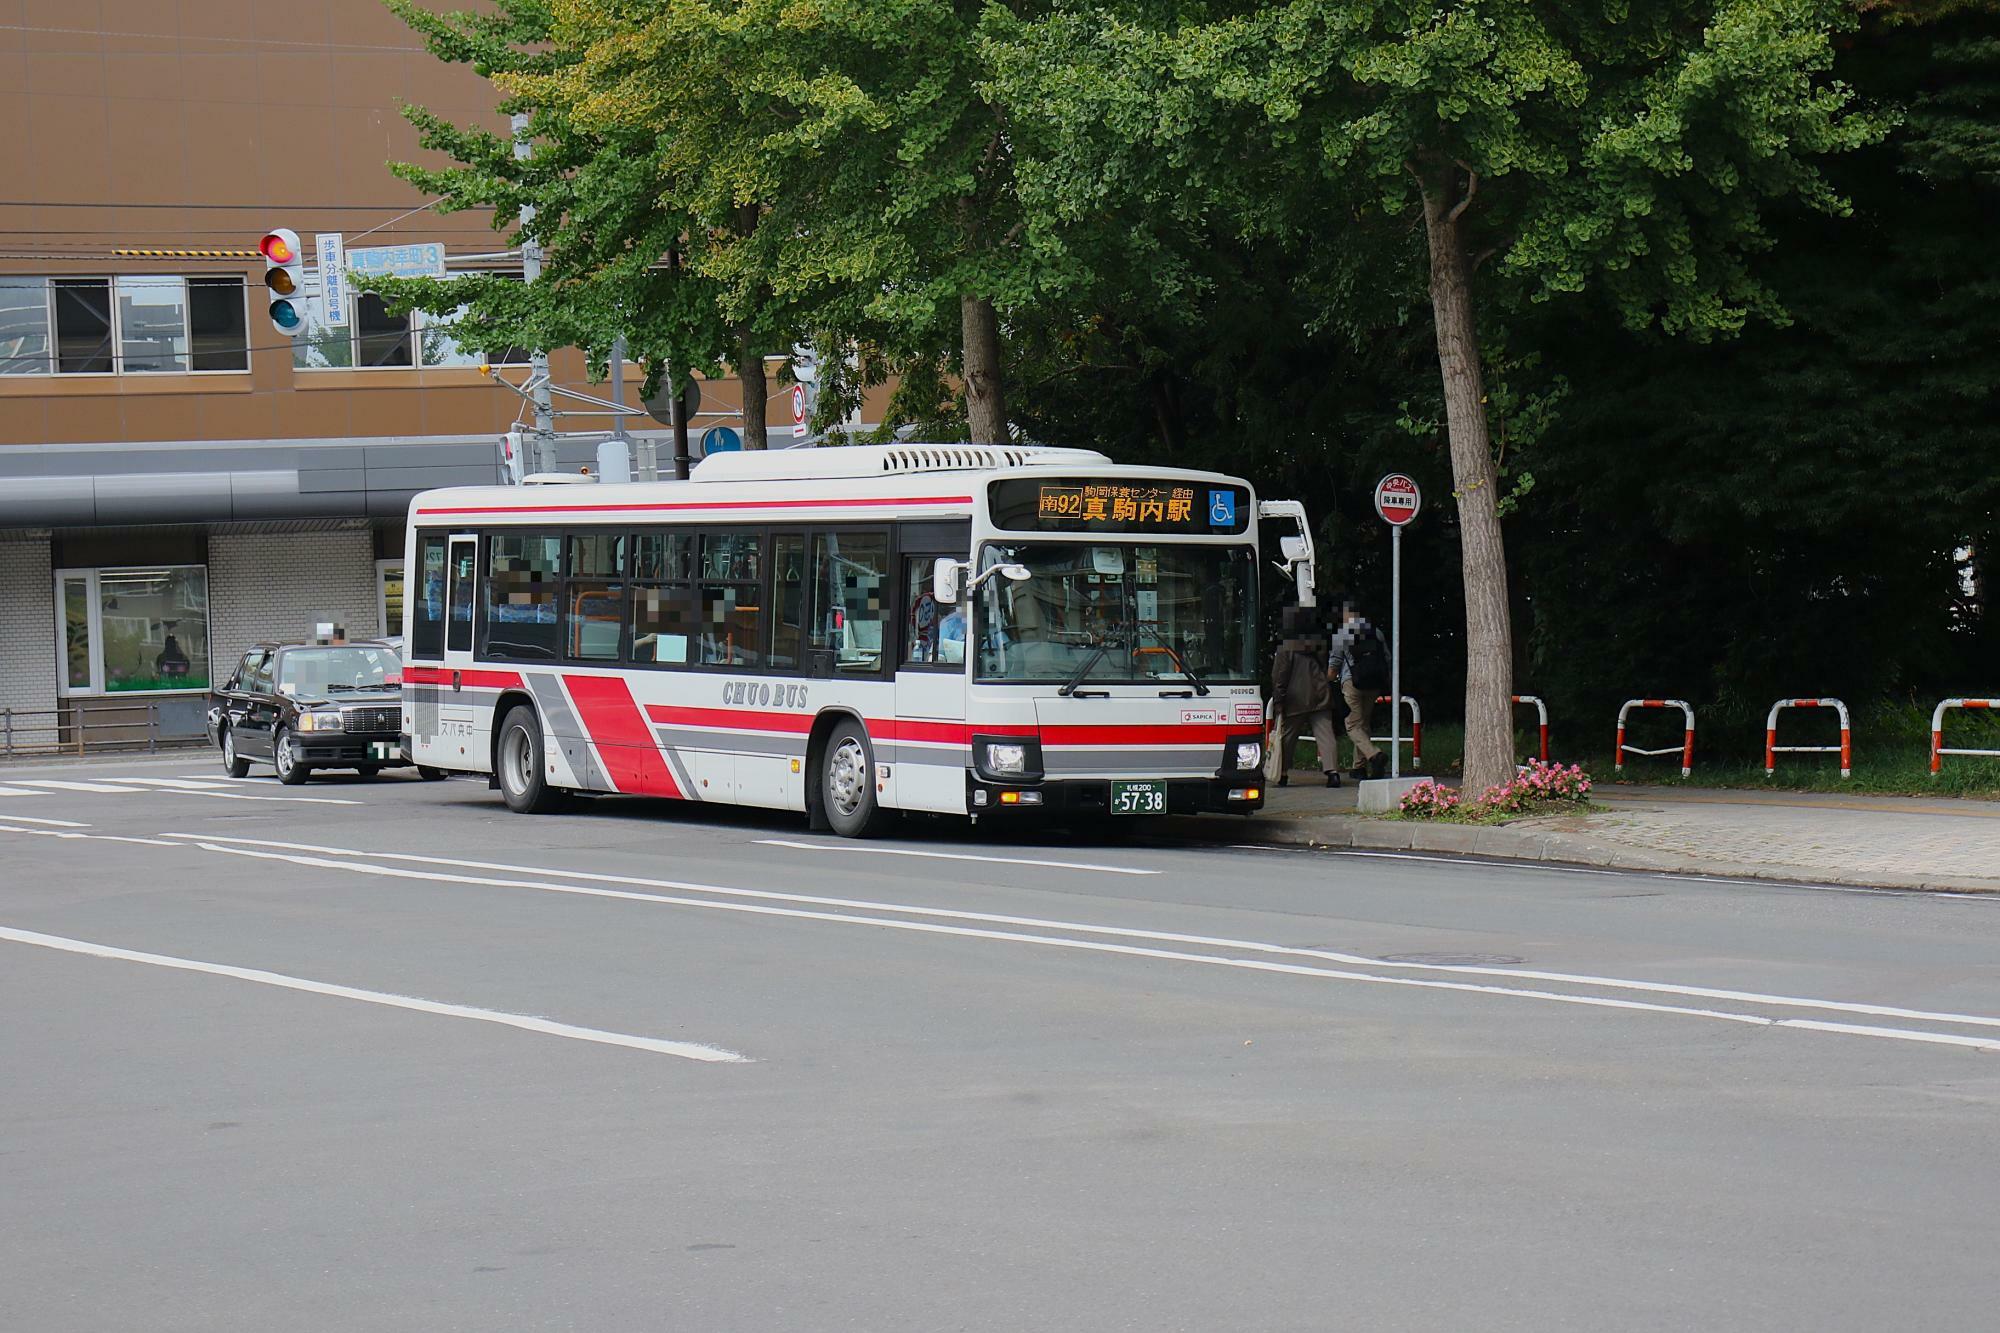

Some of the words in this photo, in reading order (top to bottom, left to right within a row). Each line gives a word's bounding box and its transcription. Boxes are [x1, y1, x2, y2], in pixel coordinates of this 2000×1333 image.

[324, 240, 341, 321] 歩車分離信号機
[1084, 485, 1167, 497] 駒岡保養センター
[1172, 487, 1194, 499] 経由
[1041, 494, 1079, 514] 南92
[1082, 498, 1192, 522] 真駒内駅
[723, 681, 770, 706] CHUO
[772, 684, 808, 708] BUS
[1121, 792, 1163, 811] 57-38
